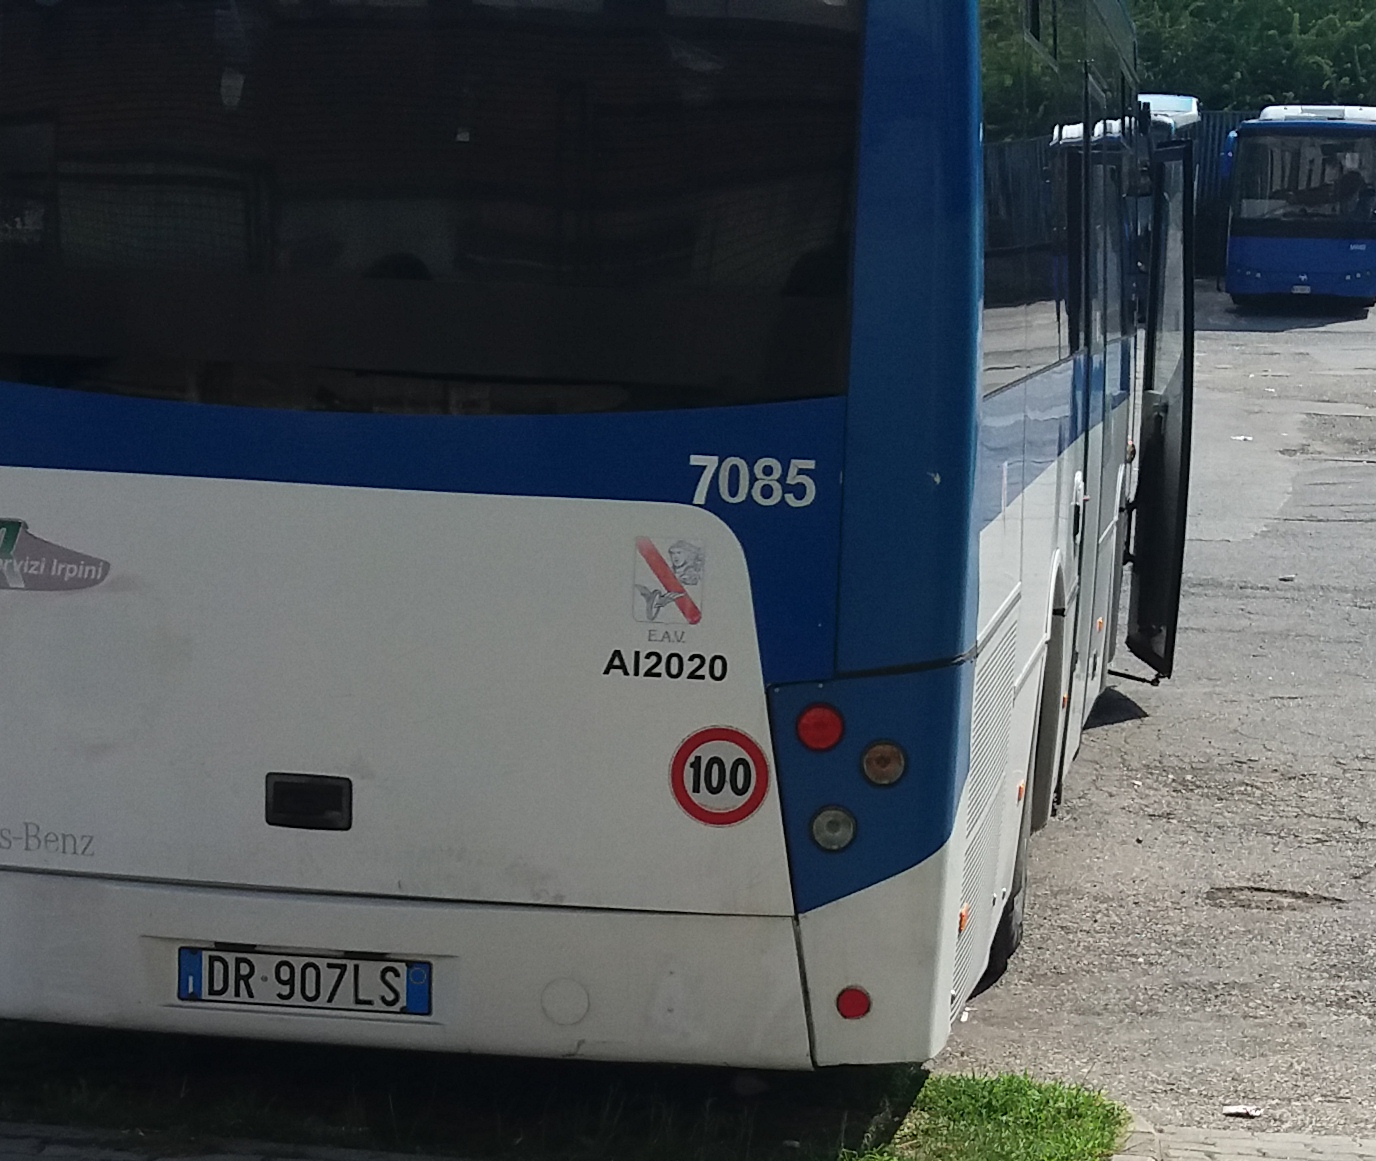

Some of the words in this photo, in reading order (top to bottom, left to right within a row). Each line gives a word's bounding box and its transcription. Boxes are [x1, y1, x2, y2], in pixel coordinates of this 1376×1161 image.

[689, 454, 817, 508] 7085
[50, 559, 104, 581] Irpini
[647, 628, 687, 644] E.A.V.
[602, 649, 729, 682] AI2020
[688, 755, 753, 797] 100
[207, 954, 256, 998] DR
[274, 959, 402, 1007] 907LS
